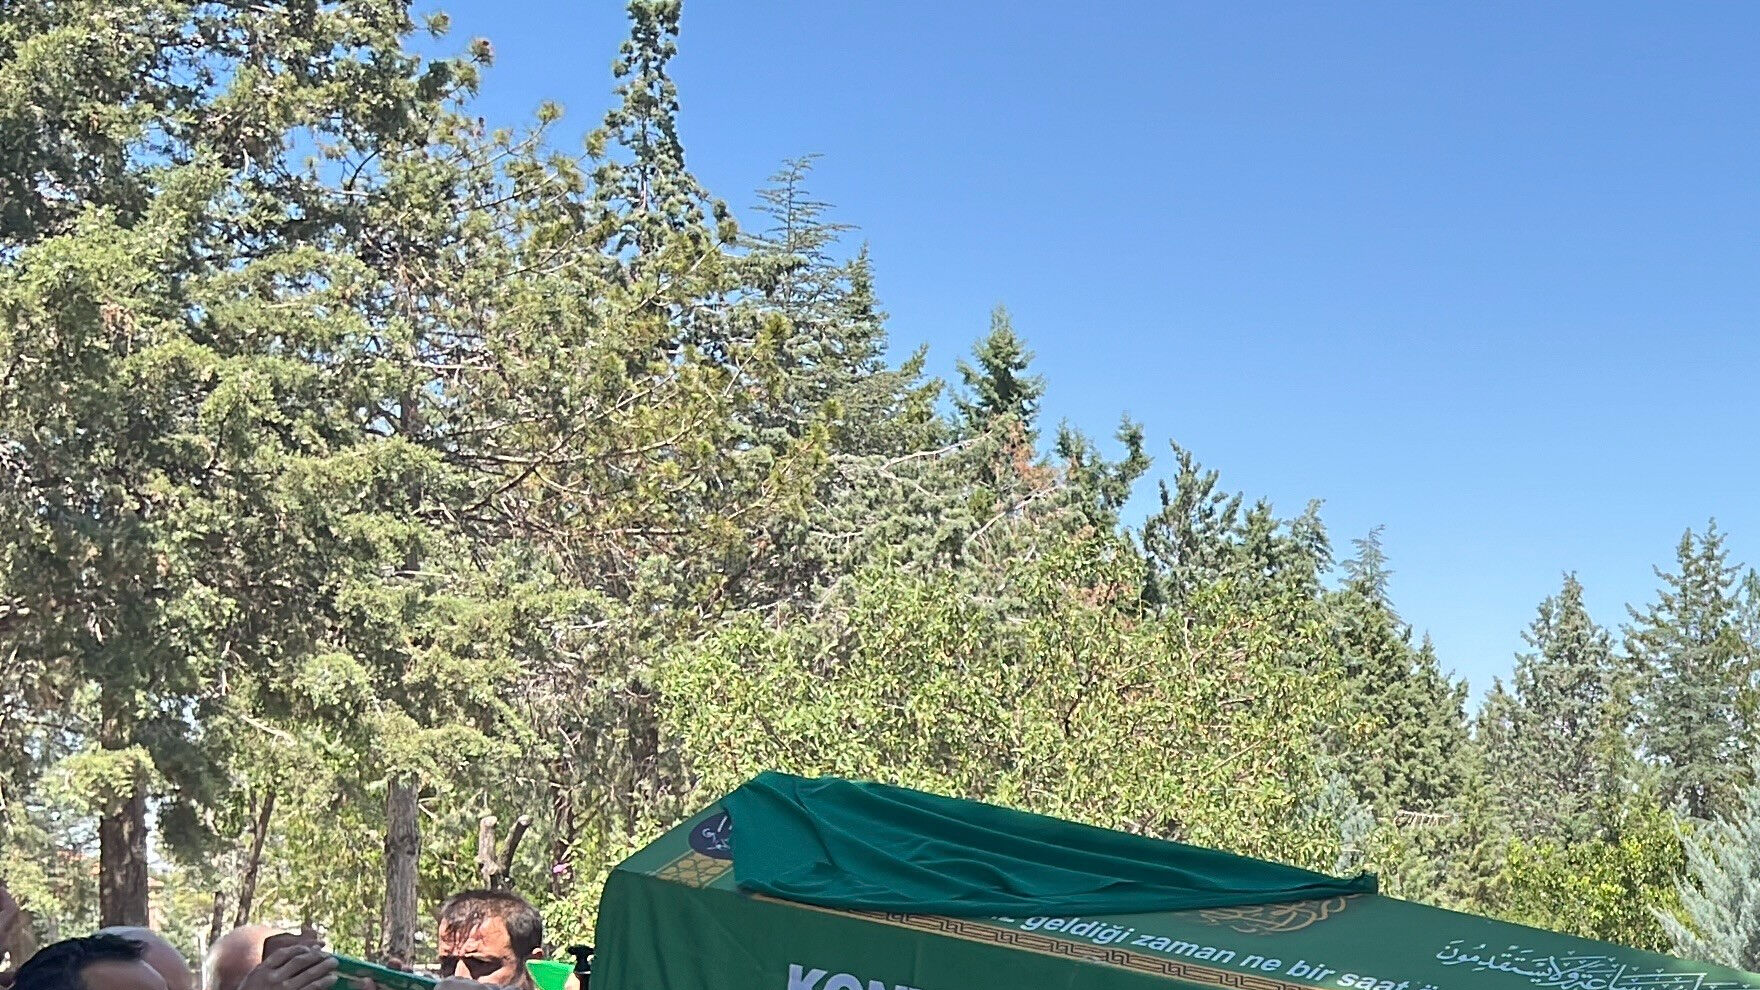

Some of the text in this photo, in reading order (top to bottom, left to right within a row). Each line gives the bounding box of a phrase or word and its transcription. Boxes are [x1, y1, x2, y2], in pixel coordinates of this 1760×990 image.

[1020, 916, 1135, 944] geldiği
[1131, 932, 1236, 964] zaman
[1239, 953, 1282, 972] ne
[1286, 959, 1335, 983] bir
